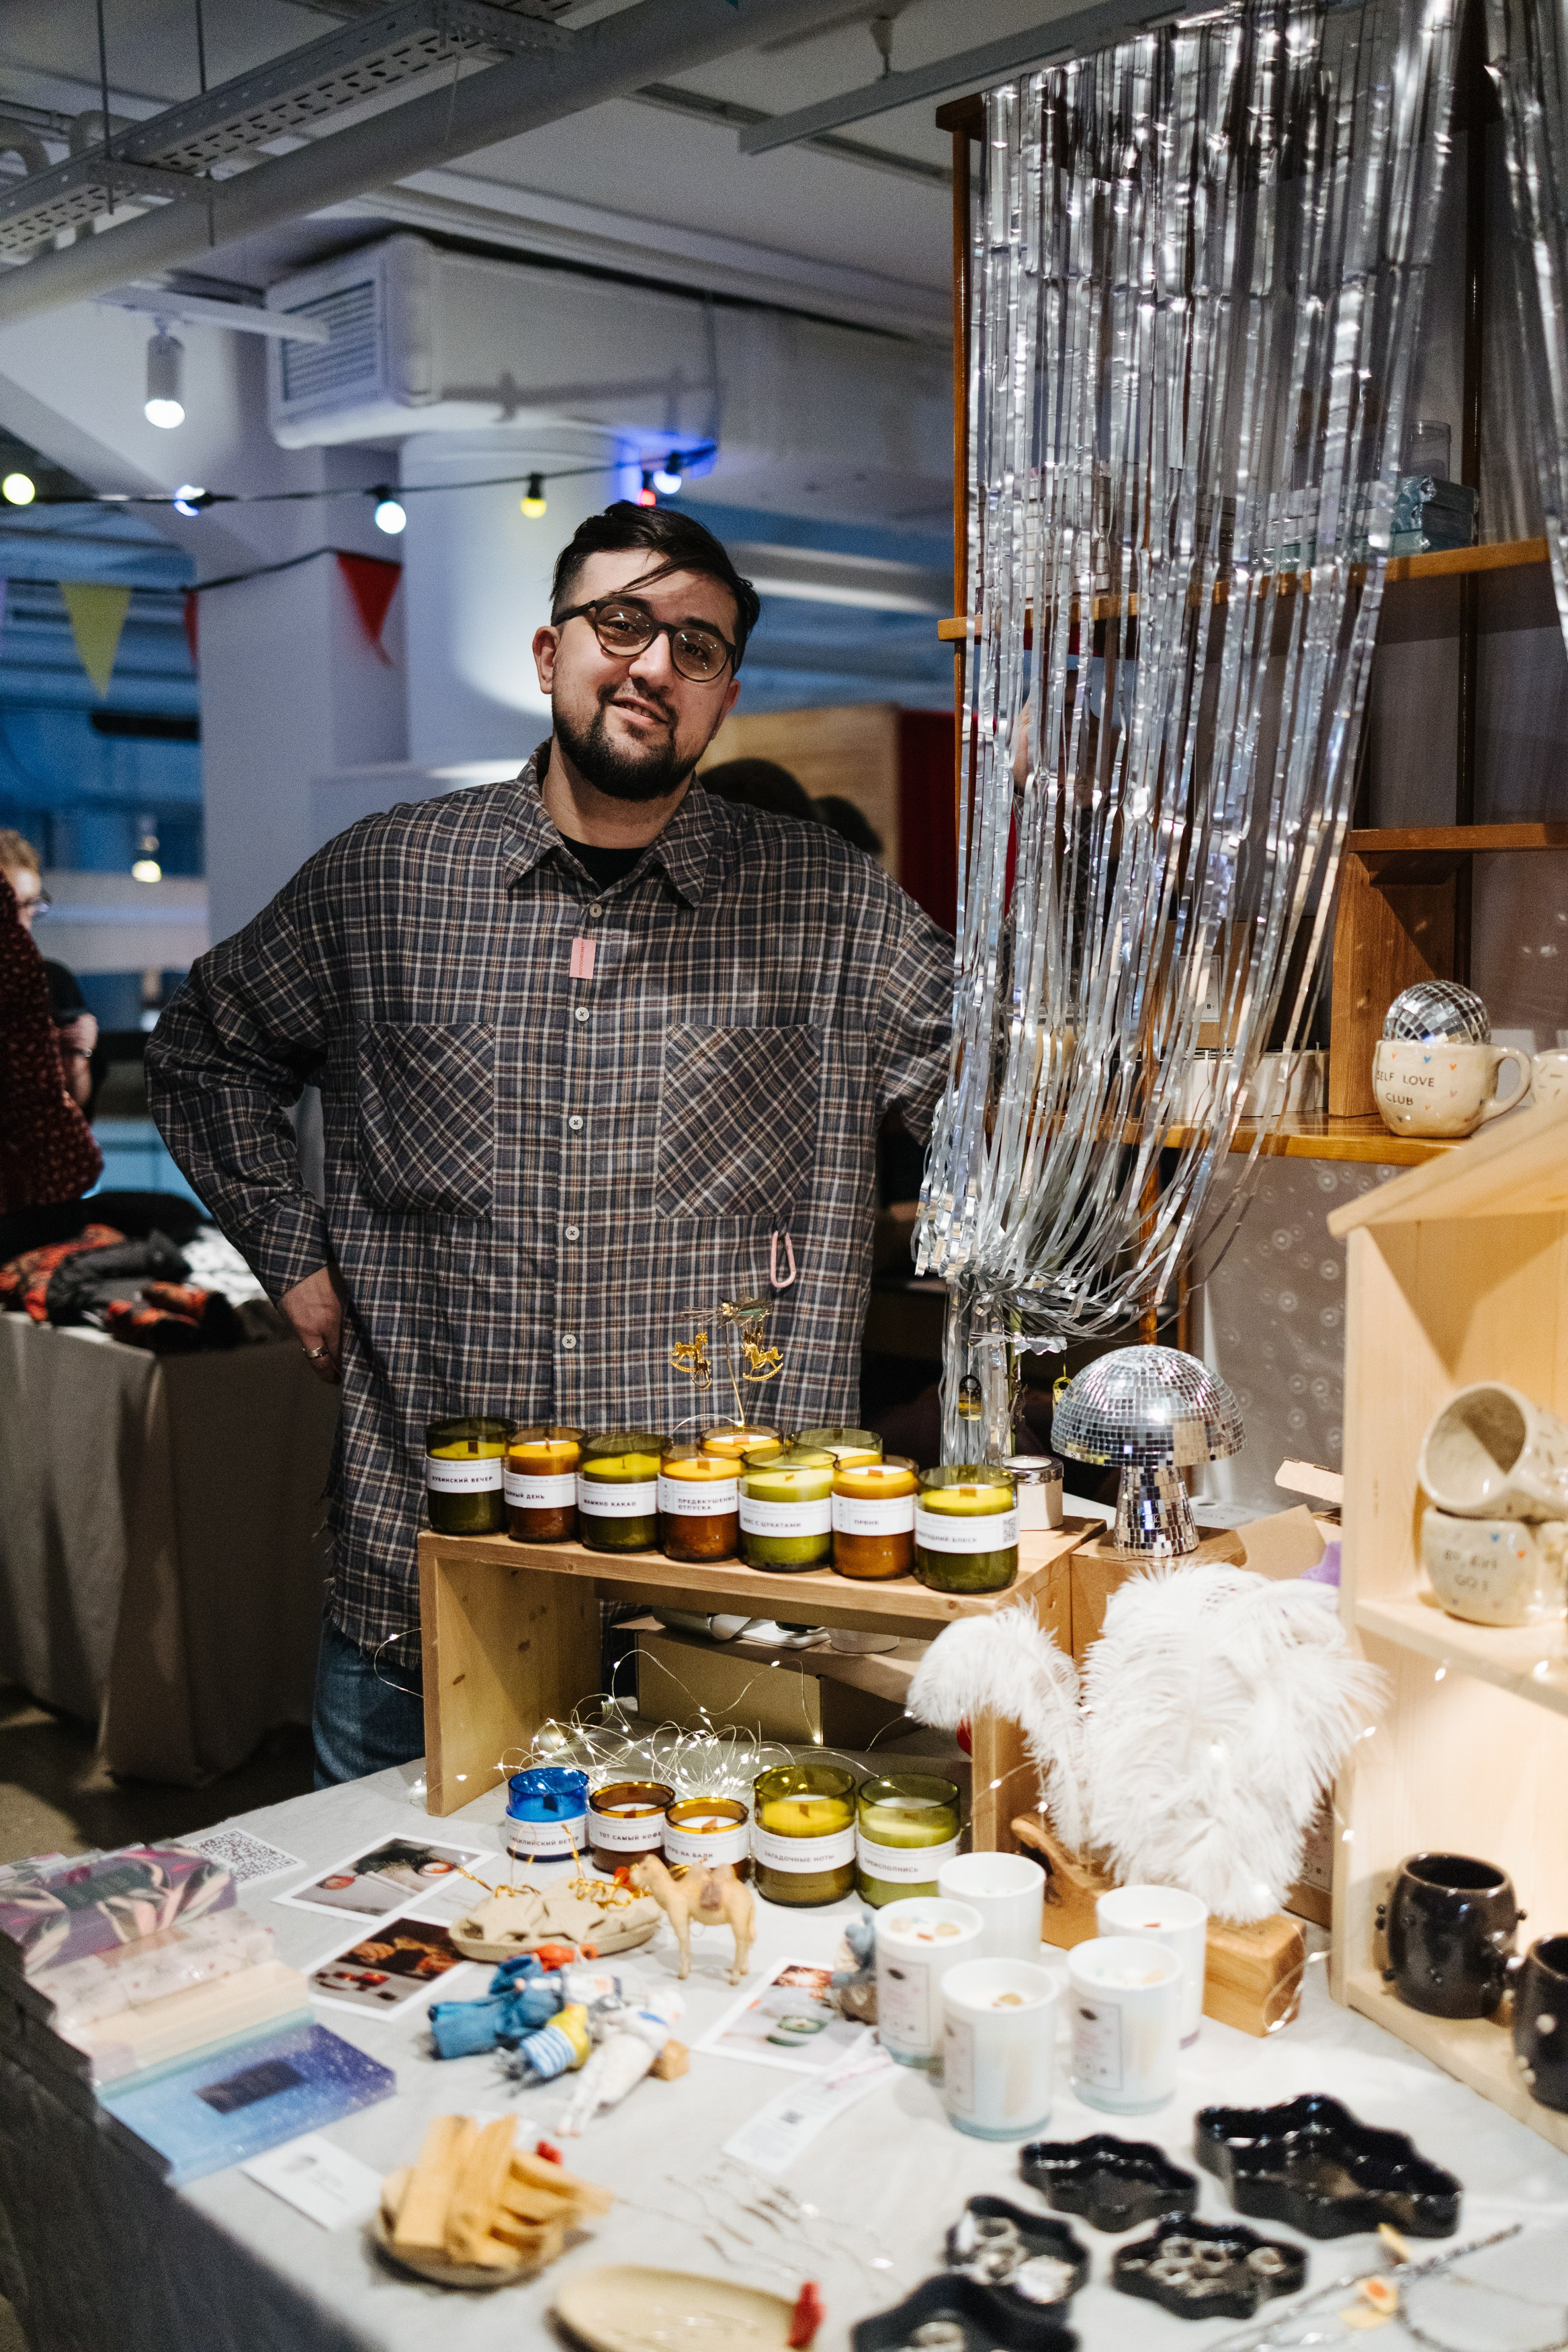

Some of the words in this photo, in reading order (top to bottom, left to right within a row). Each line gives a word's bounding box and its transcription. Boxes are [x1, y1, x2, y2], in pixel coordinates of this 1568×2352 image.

[1375, 1070, 1394, 1081] SELF
[1403, 1075, 1434, 1087] LOVE
[1386, 1093, 1413, 1105] CLUB
[677, 1495, 736, 1505] ПРЕДВКУШЕНИЕ
[559, 1835, 579, 1845] ВЕТР
[814, 1854, 834, 1862] НОТЫ
